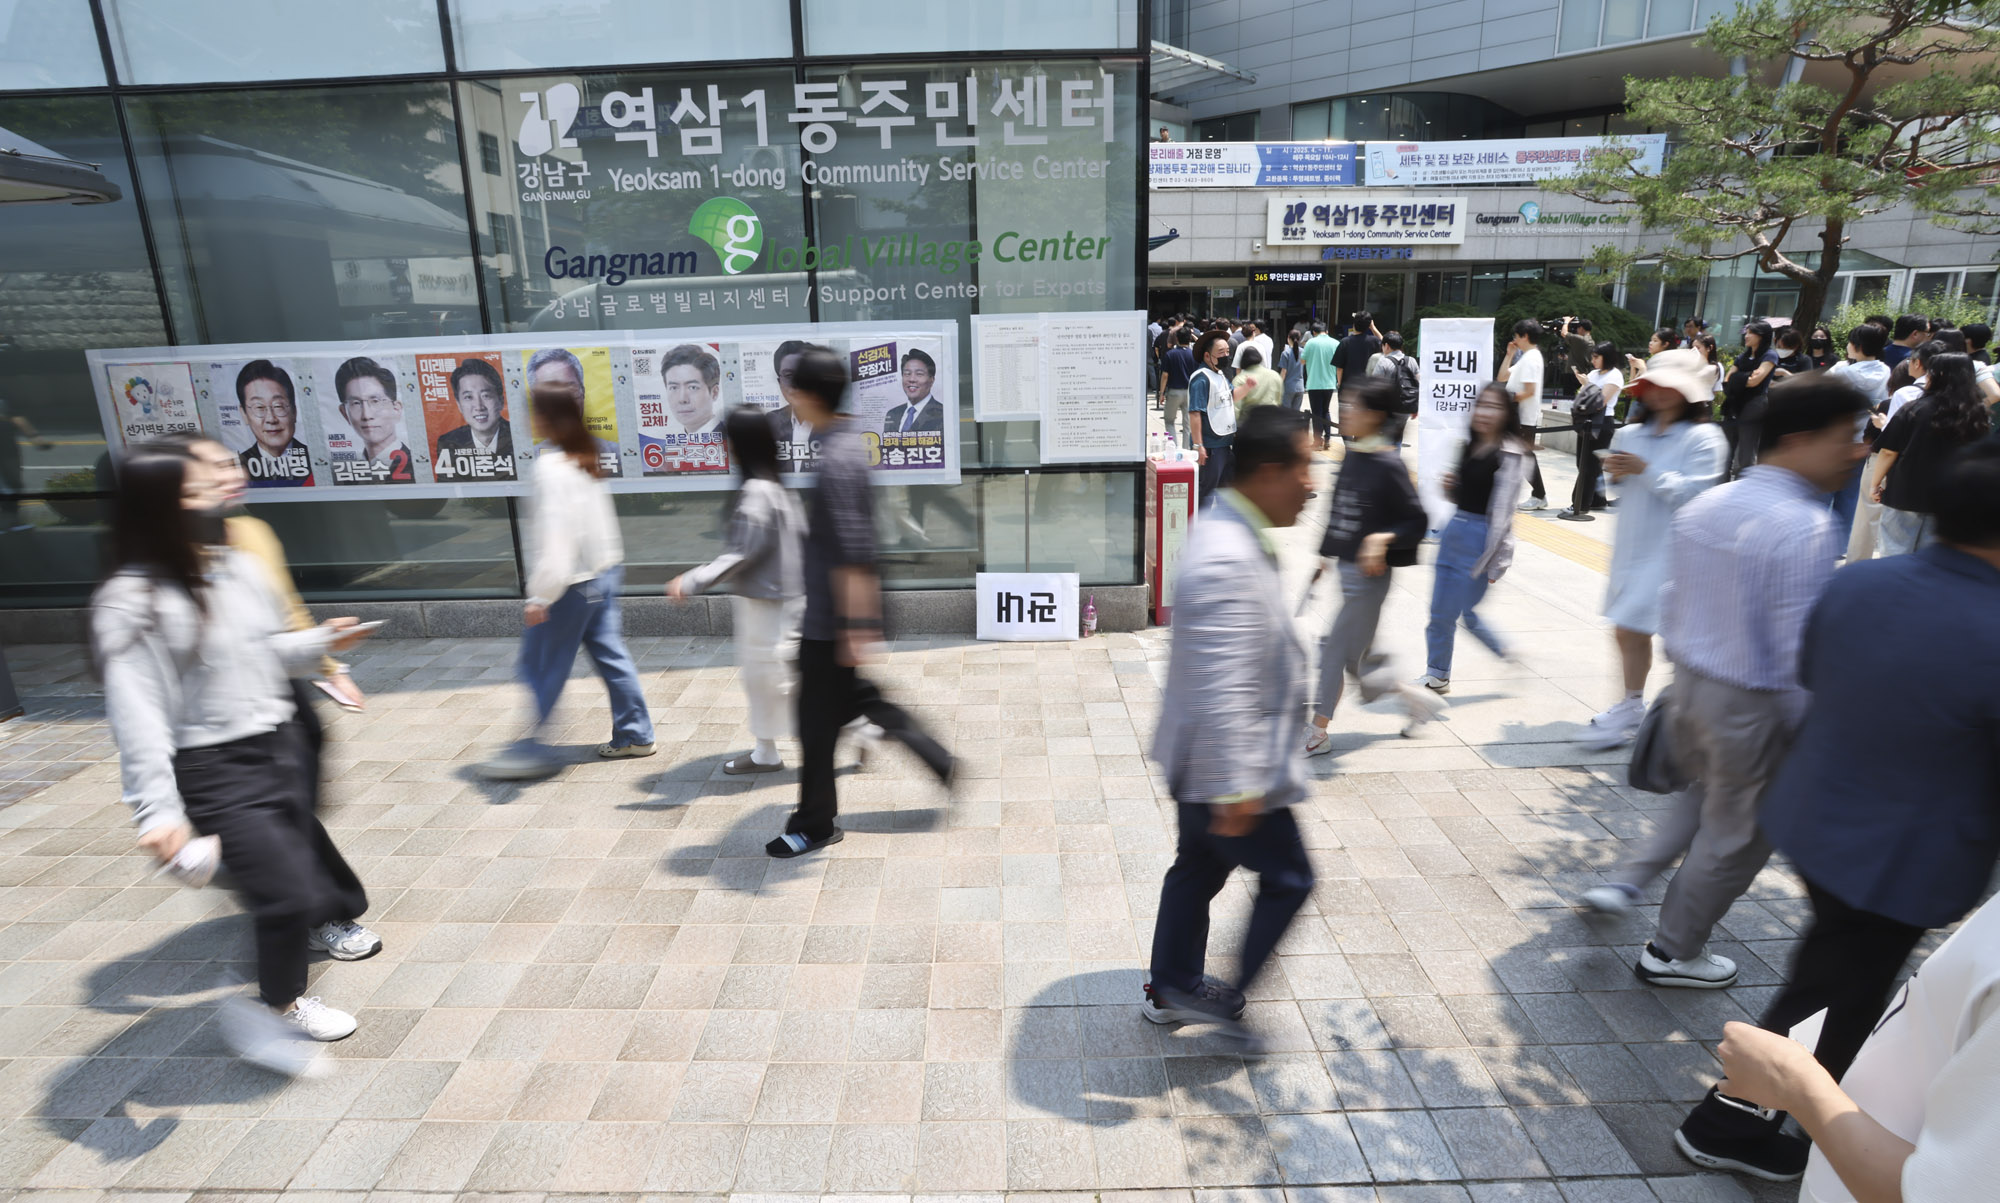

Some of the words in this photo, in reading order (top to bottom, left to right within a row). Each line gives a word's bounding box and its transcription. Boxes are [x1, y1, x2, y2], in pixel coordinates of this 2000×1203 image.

[600, 74, 1114, 157] 역삼1동주민센터
[1150, 148, 1184, 160] 분리배출
[1186, 148, 1203, 160] 거점
[1400, 154, 1421, 167] 세탁
[1424, 154, 1435, 166] 및
[1438, 154, 1449, 166] 짐
[1452, 153, 1475, 165] 보관
[1476, 152, 1510, 165] 서비스
[518, 161, 591, 188] 강남구
[608, 167, 702, 192] Yeoksam
[711, 164, 786, 190] 1-dong
[801, 159, 931, 186] Community
[939, 156, 1023, 181] Service
[1033, 155, 1110, 179] Center
[1218, 162, 1251, 174] 드립니다
[522, 191, 552, 202] GANG
[553, 190, 575, 201] NAM
[576, 189, 591, 199] GU
[1312, 204, 1455, 226] 역삼1동주민센터
[1476, 213, 1520, 226] Gangnam
[1562, 213, 1597, 226] Village
[1282, 227, 1306, 236] 강남구
[1312, 230, 1340, 239] Yeoksam
[1343, 230, 1365, 240] 1-dong
[1367, 229, 1403, 240] Community
[1404, 229, 1428, 238] Service
[1429, 229, 1452, 238] Center
[544, 246, 698, 286] Gangnam
[861, 238, 983, 274] Village
[992, 230, 1111, 263] Center
[1254, 273, 1268, 281] 365
[1269, 273, 1323, 282] 무인민원발급창구
[548, 288, 791, 318] 강남글로벌빌리지센터
[821, 283, 905, 304] Support
[915, 280, 986, 300] Center
[995, 279, 1022, 297] for
[1033, 276, 1106, 298] Expats
[857, 346, 891, 364] 선경제,
[1433, 350, 1478, 373] 관내
[419, 358, 456, 373] 미래를
[421, 373, 447, 387] 여는
[424, 387, 449, 402] 선택
[1432, 383, 1477, 399] 선거인
[640, 402, 663, 415] 정치
[641, 415, 668, 427] 교체!
[126, 423, 165, 437] 선거벽보
[643, 444, 664, 468] 6
[665, 444, 727, 469] 구주와
[888, 446, 942, 465] 송진호
[248, 456, 310, 478] 이재명
[332, 460, 391, 482] 김문수
[389, 450, 412, 480] 2
[434, 449, 456, 478] 4
[456, 454, 514, 478] 이준석
